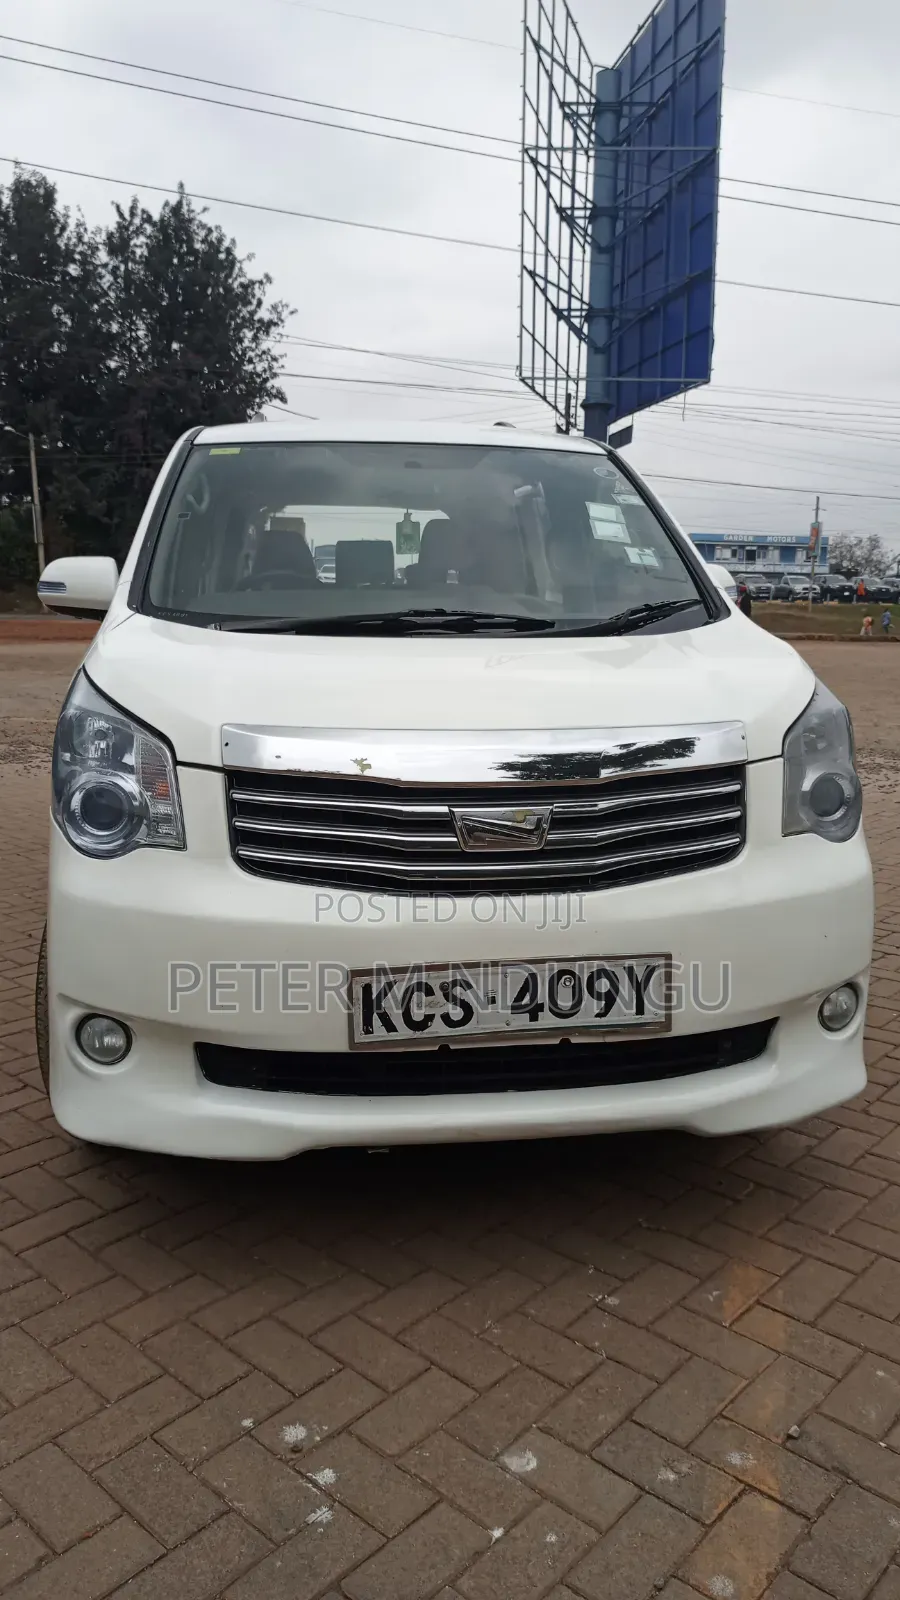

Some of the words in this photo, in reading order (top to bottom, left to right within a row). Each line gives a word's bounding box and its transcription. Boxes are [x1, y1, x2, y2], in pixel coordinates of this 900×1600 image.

[723, 534, 753, 542] GARDEN
[766, 535, 797, 543] MOTORS
[361, 980, 475, 1036] KCS
[511, 964, 659, 1023] 409Y
